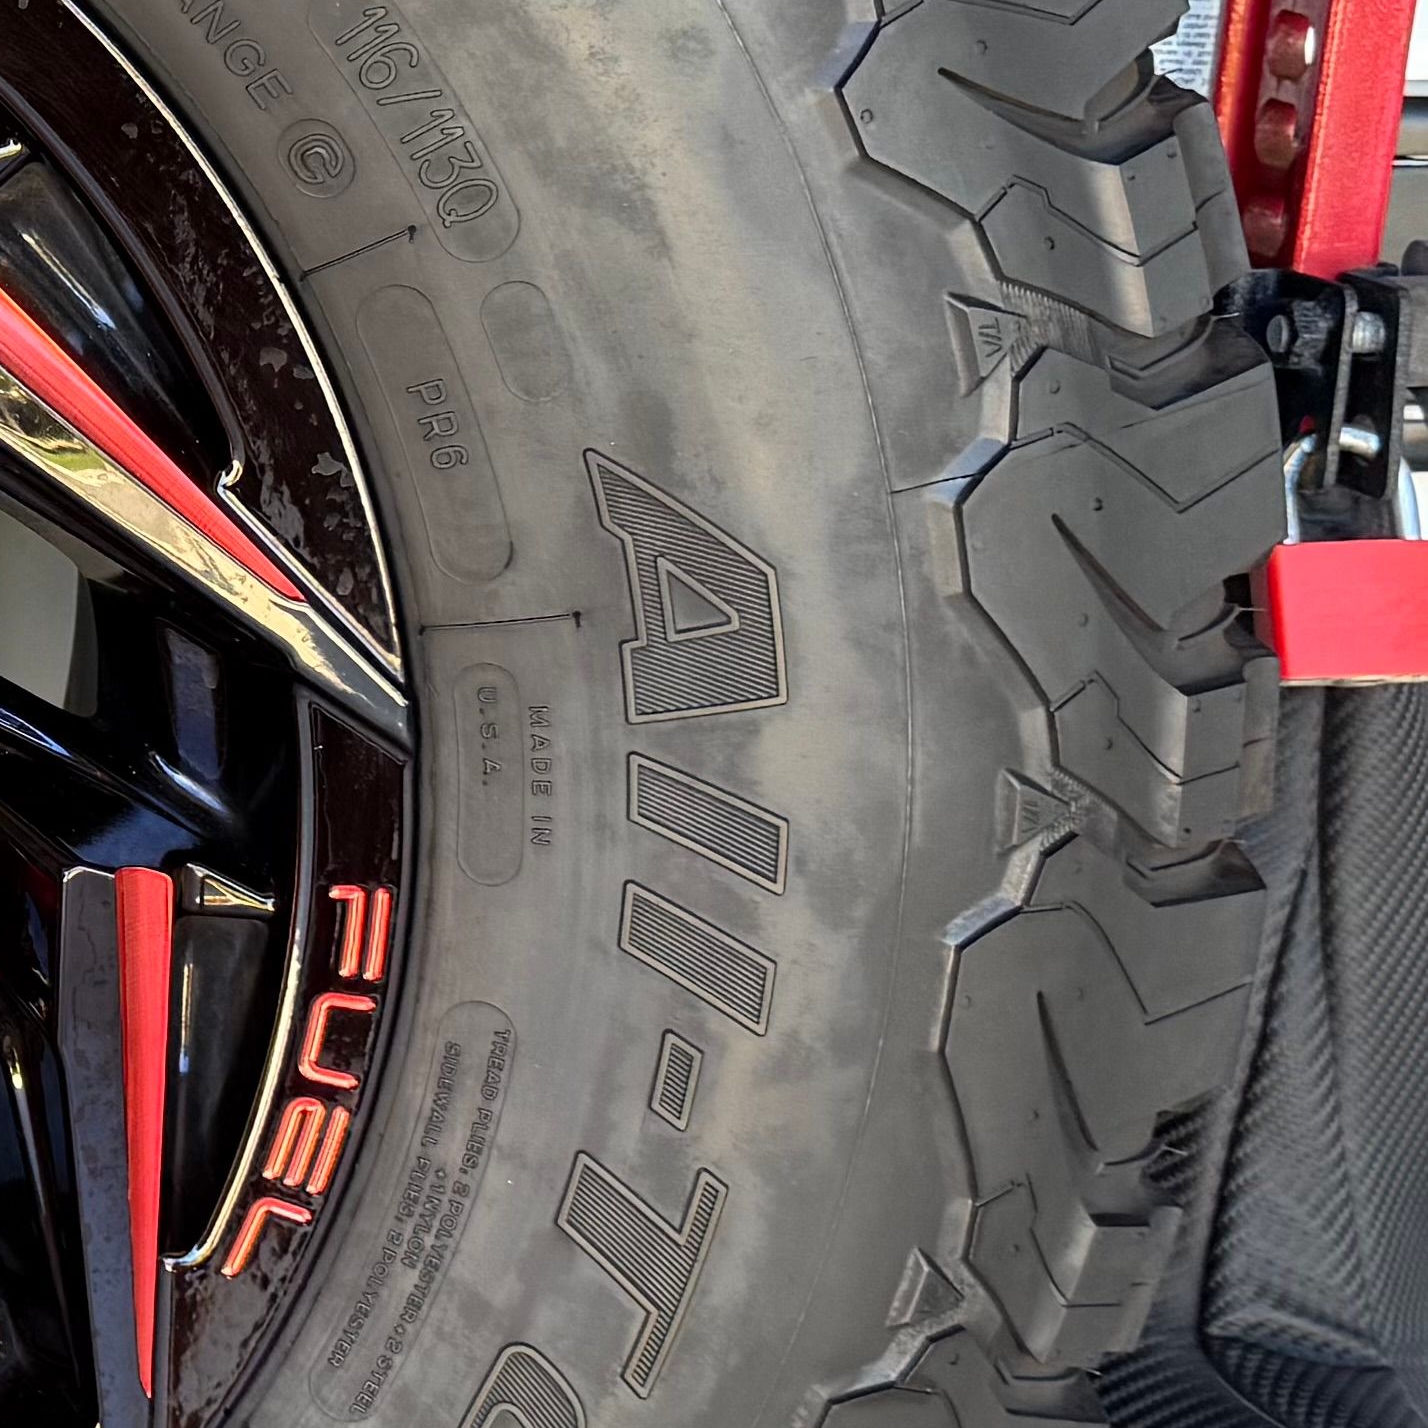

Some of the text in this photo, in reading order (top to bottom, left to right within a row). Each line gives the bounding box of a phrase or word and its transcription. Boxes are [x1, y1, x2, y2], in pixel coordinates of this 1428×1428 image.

[333, 4, 500, 230] 116/113Q
[404, 375, 470, 471] PR6
[525, 704, 553, 847] MADE IN
[221, 885, 394, 1278] FUEL
[417, 1039, 462, 1149] SIDEWALL
[478, 1027, 513, 1102] TREAD
[397, 1198, 464, 1325] POLYESTER
[398, 1194, 443, 1270] NYLON
[324, 1245, 398, 1368] POLYESTER
[346, 1352, 395, 1415] STEEL
